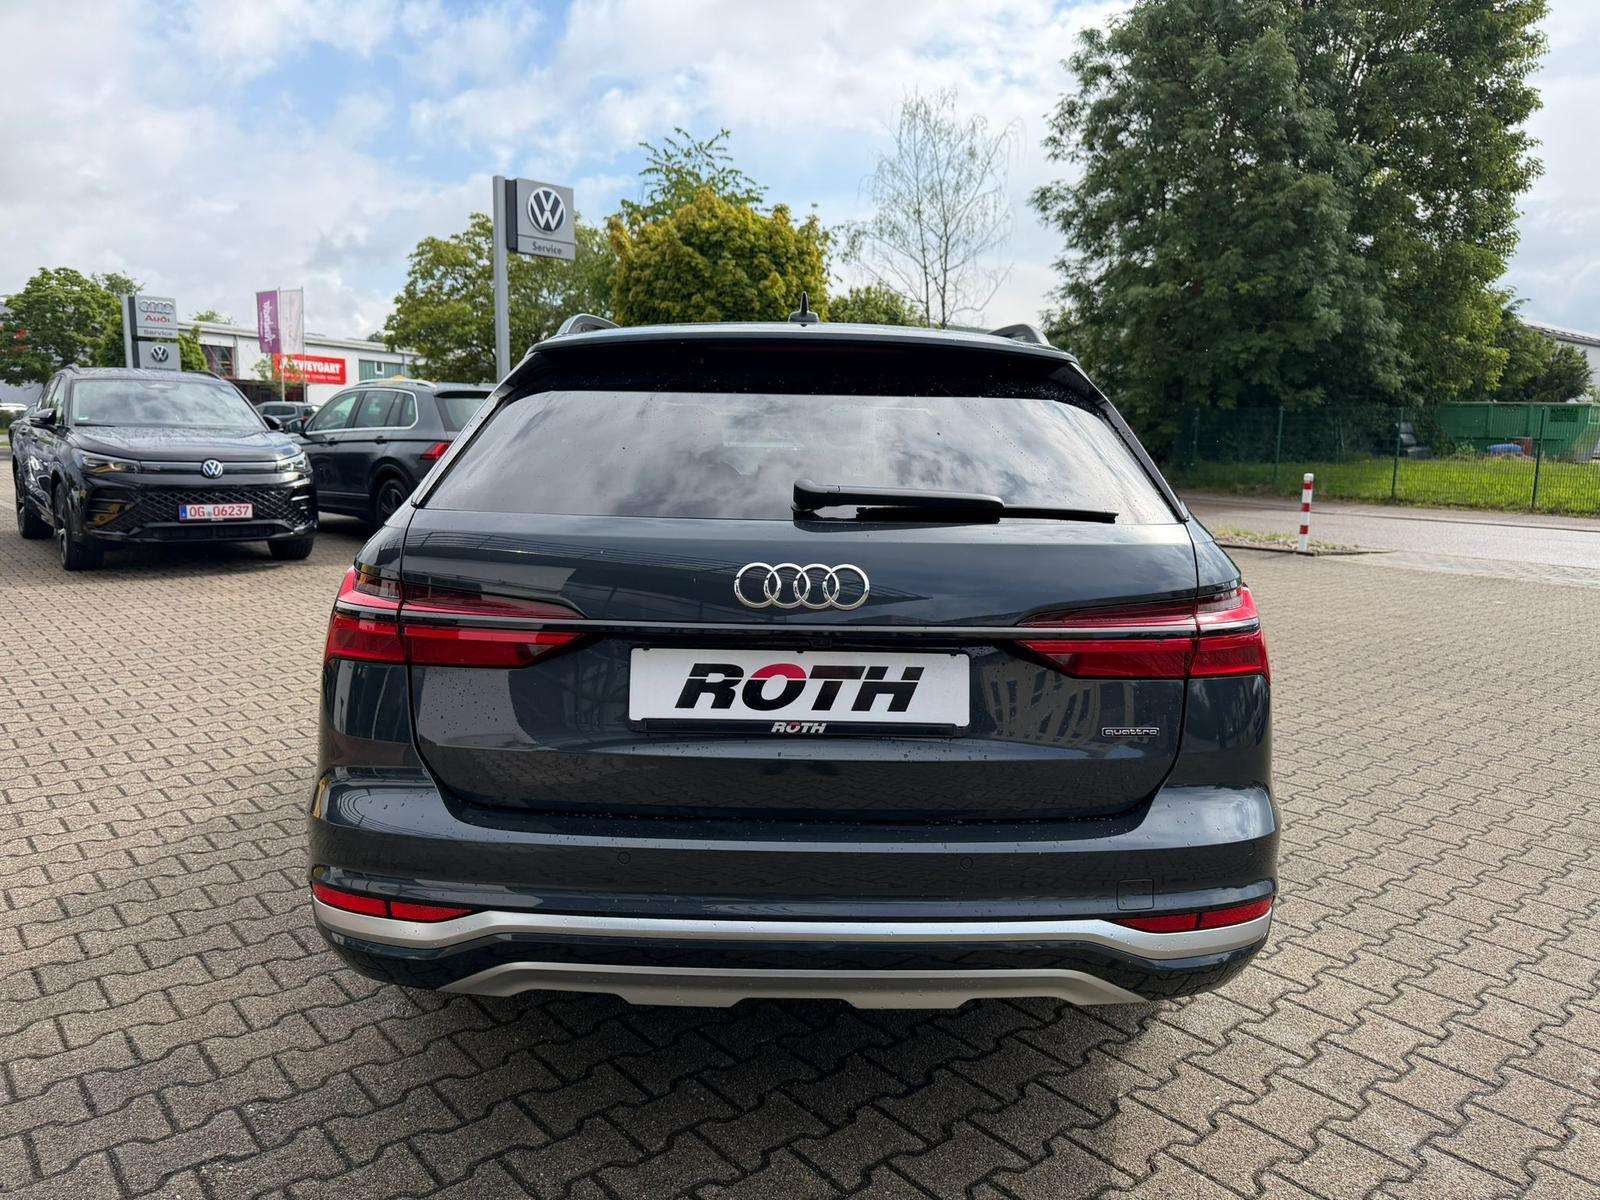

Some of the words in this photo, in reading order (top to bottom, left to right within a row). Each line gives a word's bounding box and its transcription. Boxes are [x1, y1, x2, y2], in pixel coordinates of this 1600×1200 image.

[532, 240, 562, 255] Service
[144, 314, 170, 324] Audi
[189, 506, 206, 517] OG
[212, 505, 250, 517] 06237
[674, 662, 925, 713] ROTH
[771, 721, 828, 735] ROTH
[1104, 727, 1158, 737] quattro
